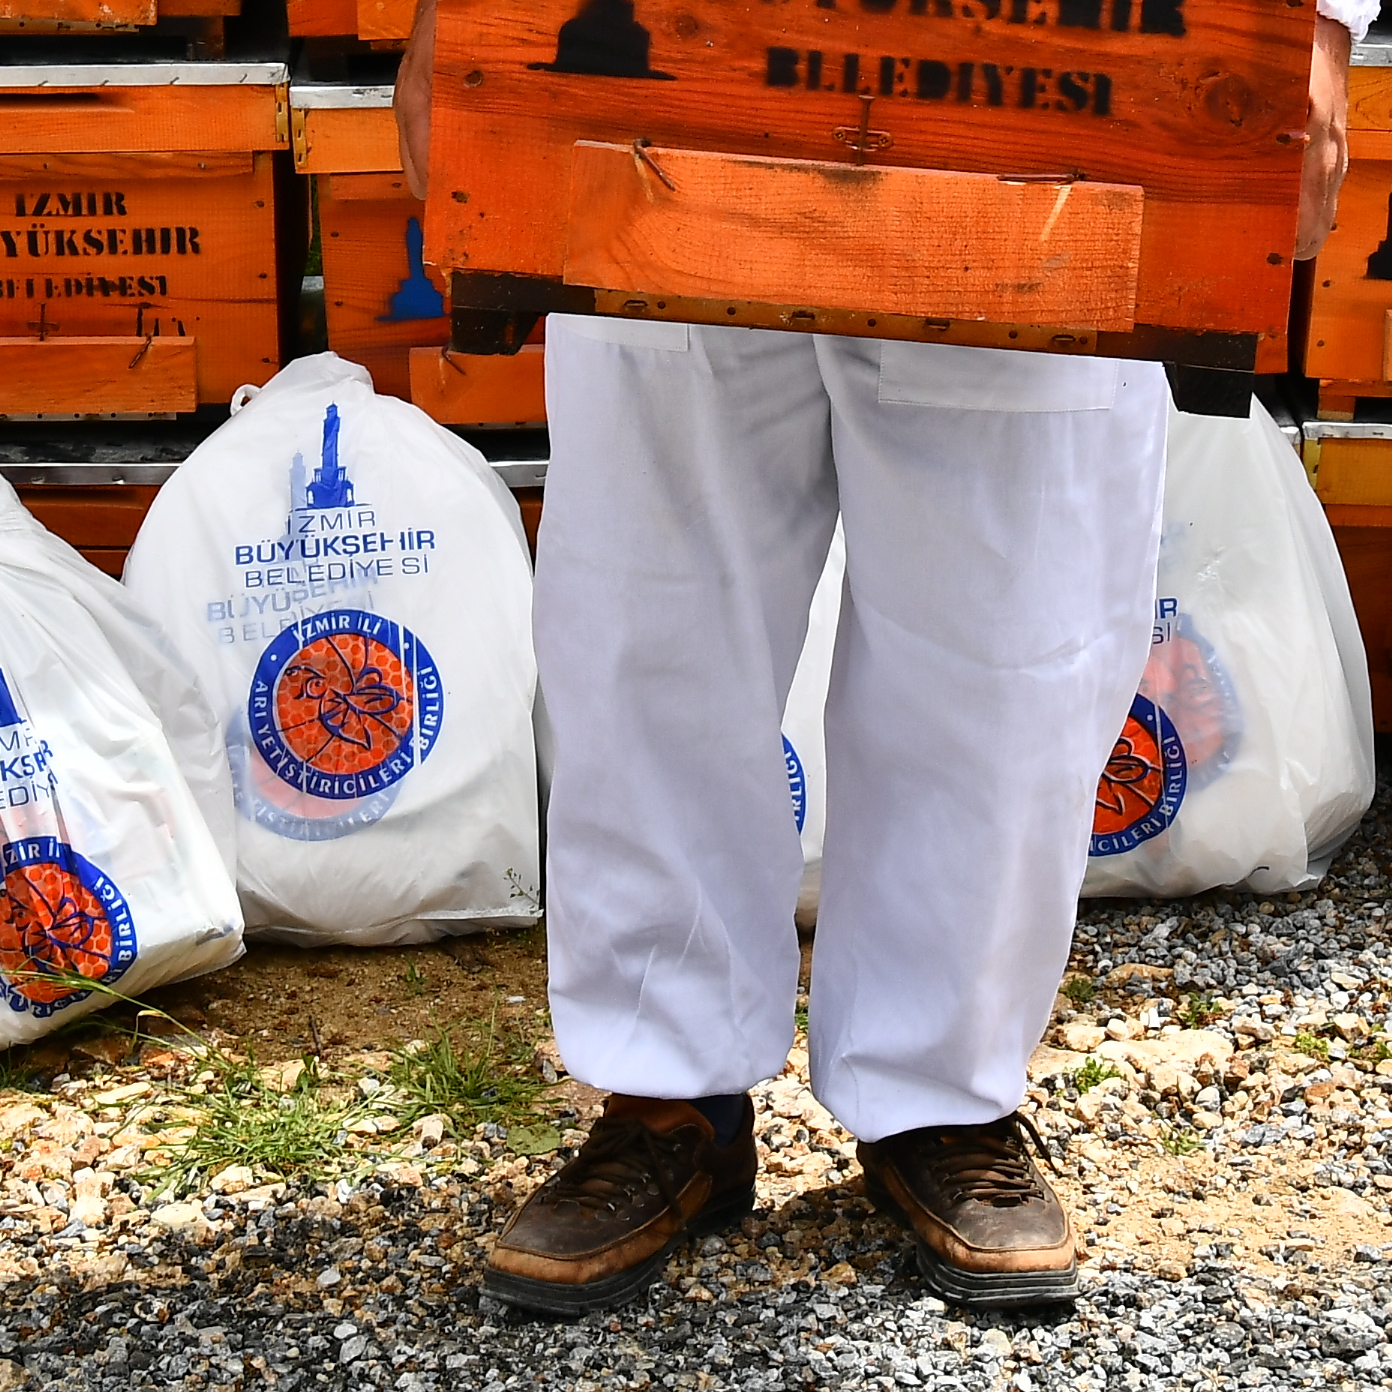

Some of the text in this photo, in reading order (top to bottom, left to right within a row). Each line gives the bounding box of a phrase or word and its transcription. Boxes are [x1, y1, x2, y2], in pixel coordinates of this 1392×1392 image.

[286, 509, 377, 536] İZMİR
[292, 614, 351, 642] İZMİR
[254, 680, 268, 718] ARI
[1158, 734, 1182, 817] BİRLİĞİ
[94, 875, 133, 962] BİRLİĞİ
